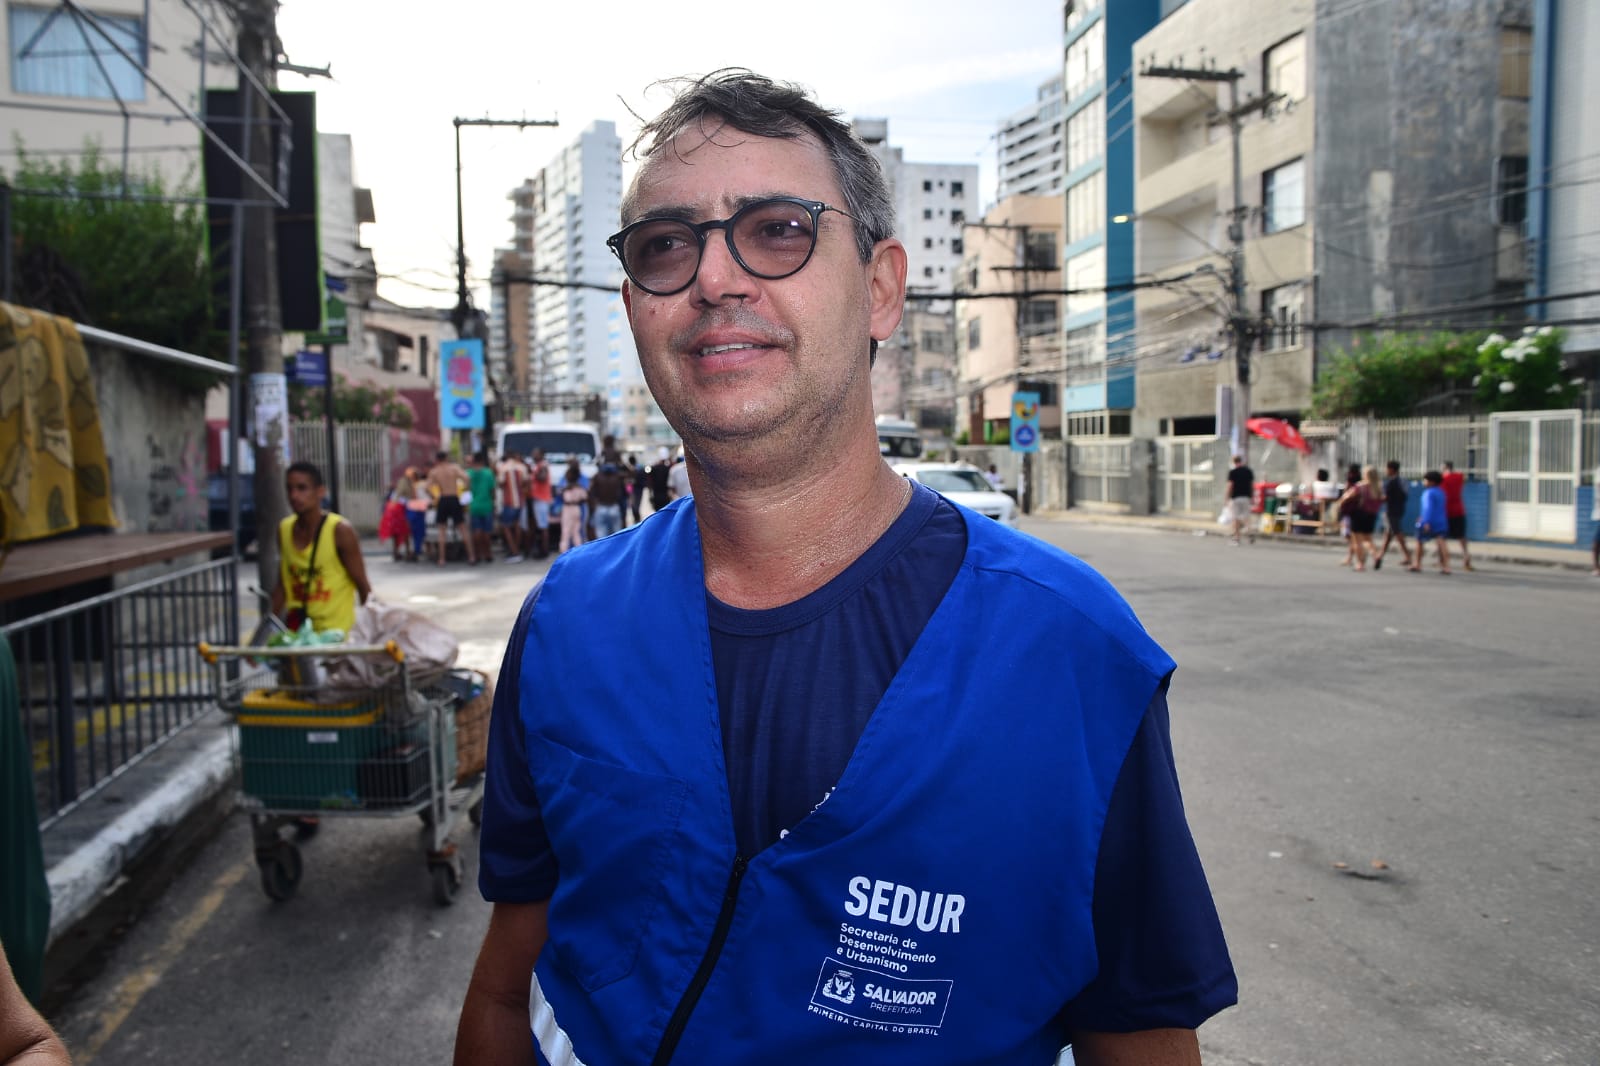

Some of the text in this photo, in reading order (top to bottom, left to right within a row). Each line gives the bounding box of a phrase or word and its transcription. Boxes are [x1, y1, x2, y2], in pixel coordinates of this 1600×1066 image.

[844, 875, 966, 934] SEDUR
[839, 934, 937, 963] Desenvolvimento
[840, 922, 918, 950] Secretaria de
[836, 946, 908, 973] e Urbanismo
[862, 983, 937, 1006] SALVADOR
[869, 1001, 923, 1015] PREFEITURA
[807, 1004, 940, 1036] PRIMEIRA CAPITAL DO BRASIL
